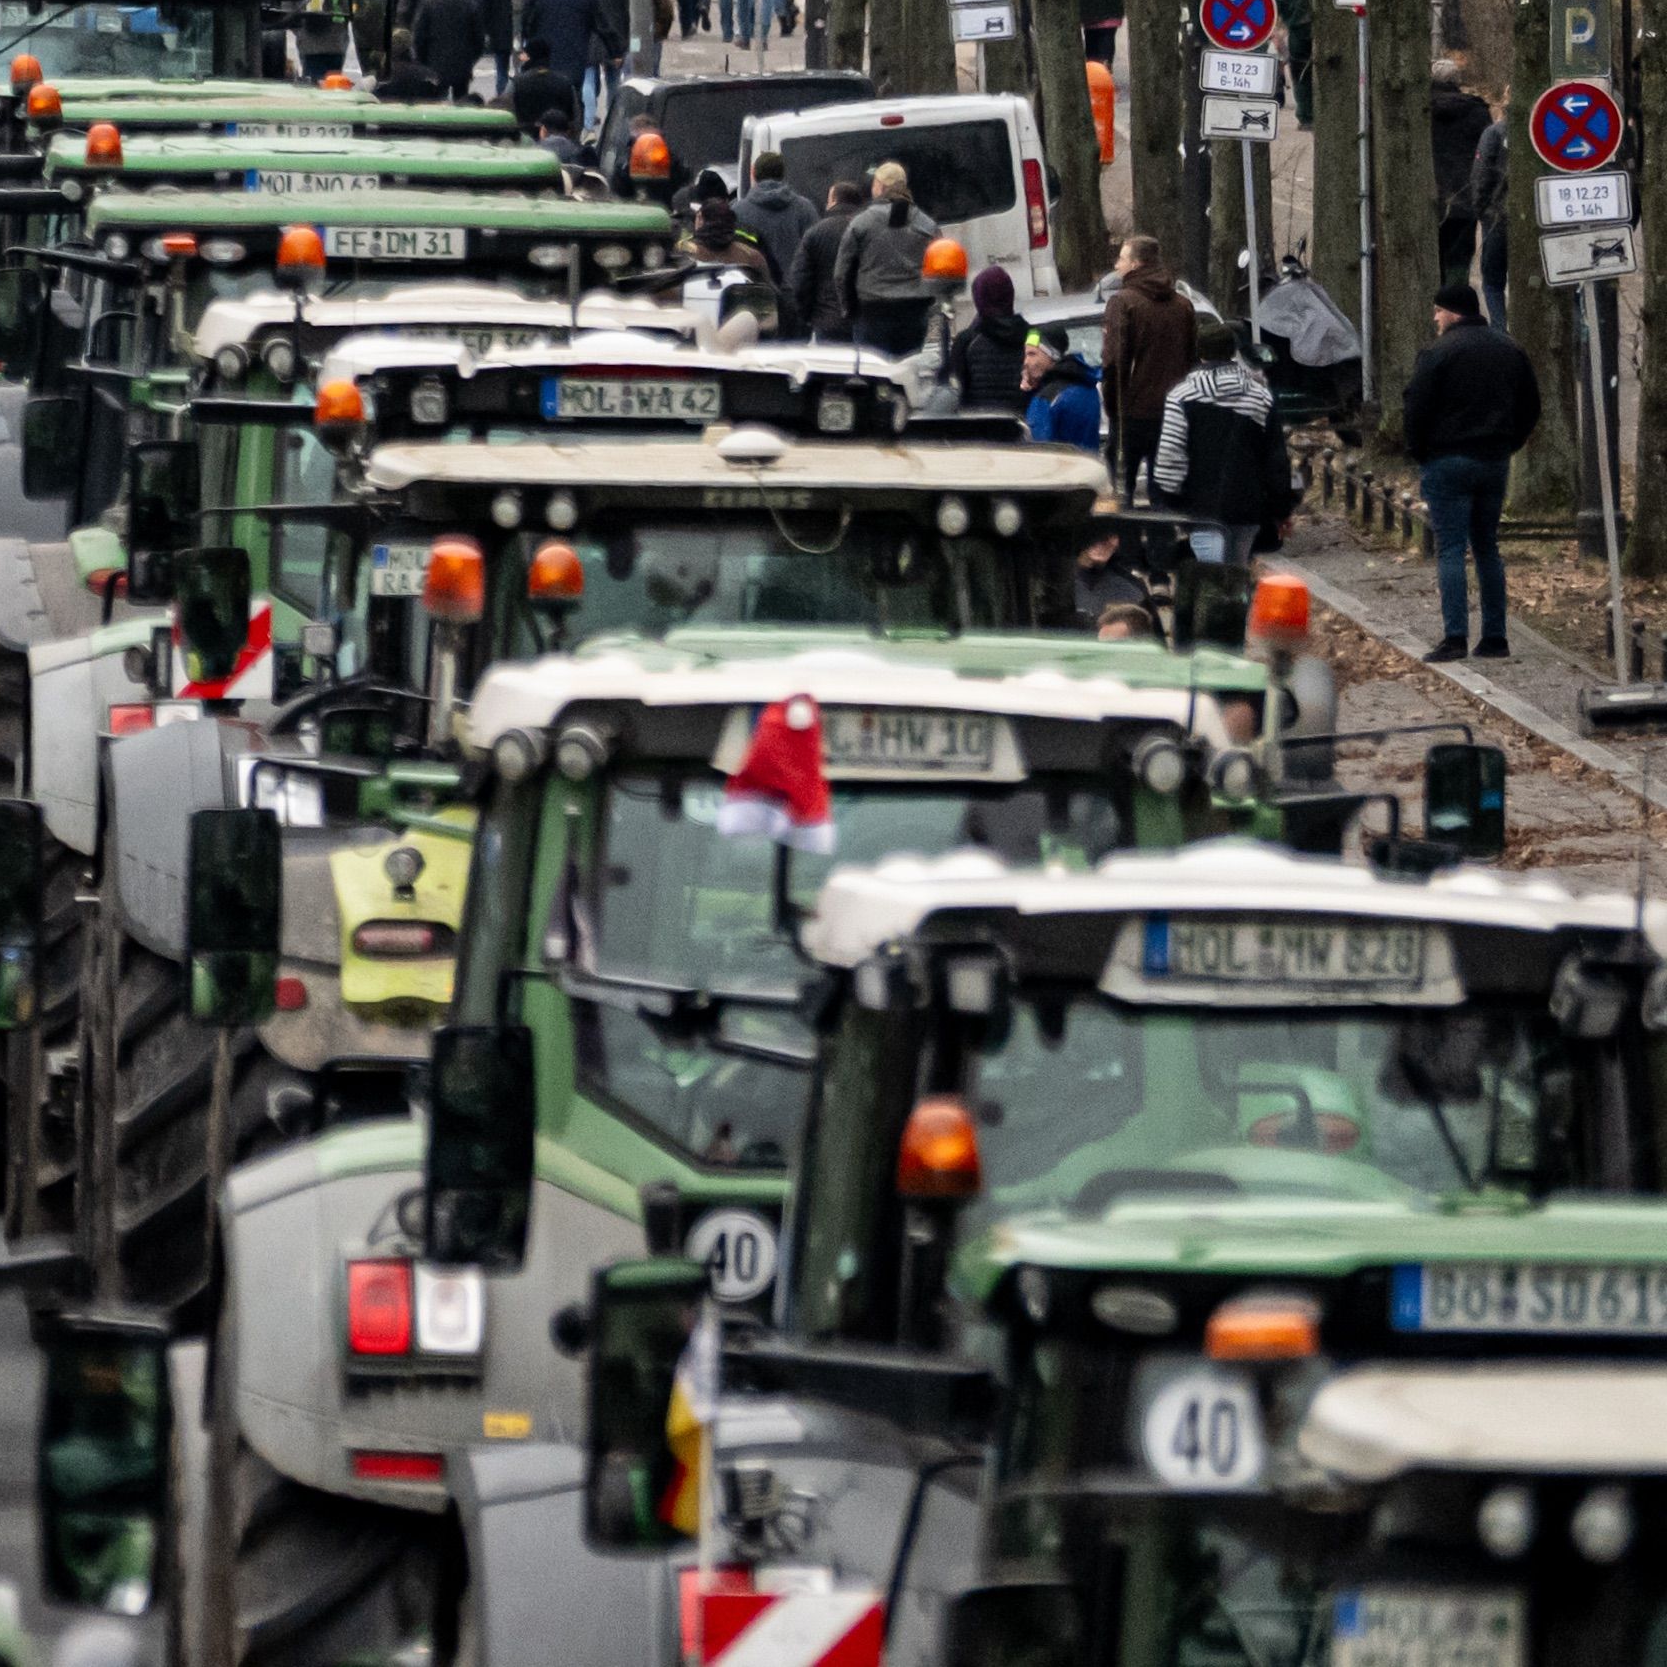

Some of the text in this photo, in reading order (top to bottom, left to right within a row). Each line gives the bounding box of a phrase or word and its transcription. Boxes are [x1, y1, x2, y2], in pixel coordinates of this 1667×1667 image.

[1557, 185, 1610, 202] 18.12.23
[1565, 202, 1604, 218] 6-14h
[336, 231, 453, 255] FF DM 31
[560, 385, 615, 415] MOL
[681, 387, 716, 416] 42
[707, 1230, 759, 1283] 40
[1170, 1397, 1239, 1479] 40
